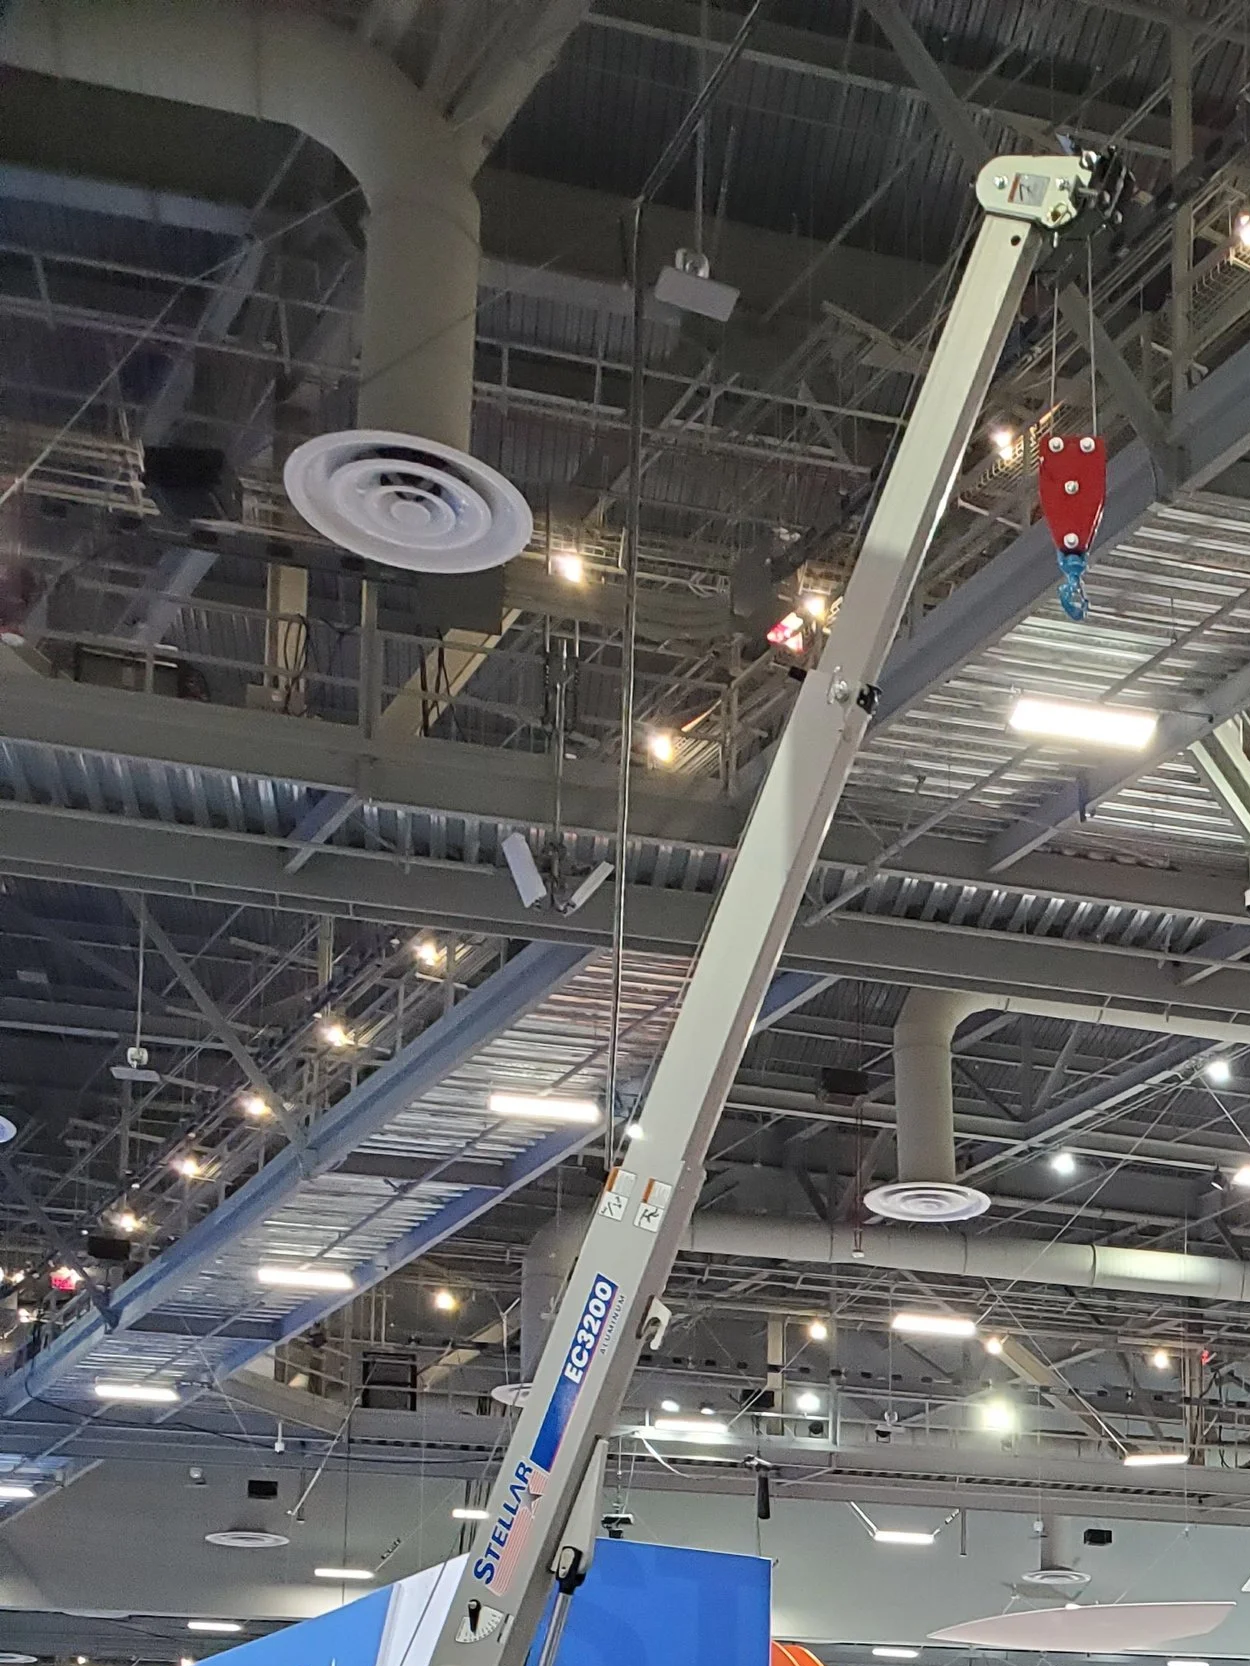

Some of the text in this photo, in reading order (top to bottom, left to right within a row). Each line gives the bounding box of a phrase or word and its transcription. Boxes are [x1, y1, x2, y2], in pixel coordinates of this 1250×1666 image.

[563, 1281, 613, 1384] EC3200
[600, 1295, 627, 1354] ALUMINUM
[473, 1460, 534, 1585] STELLAR
